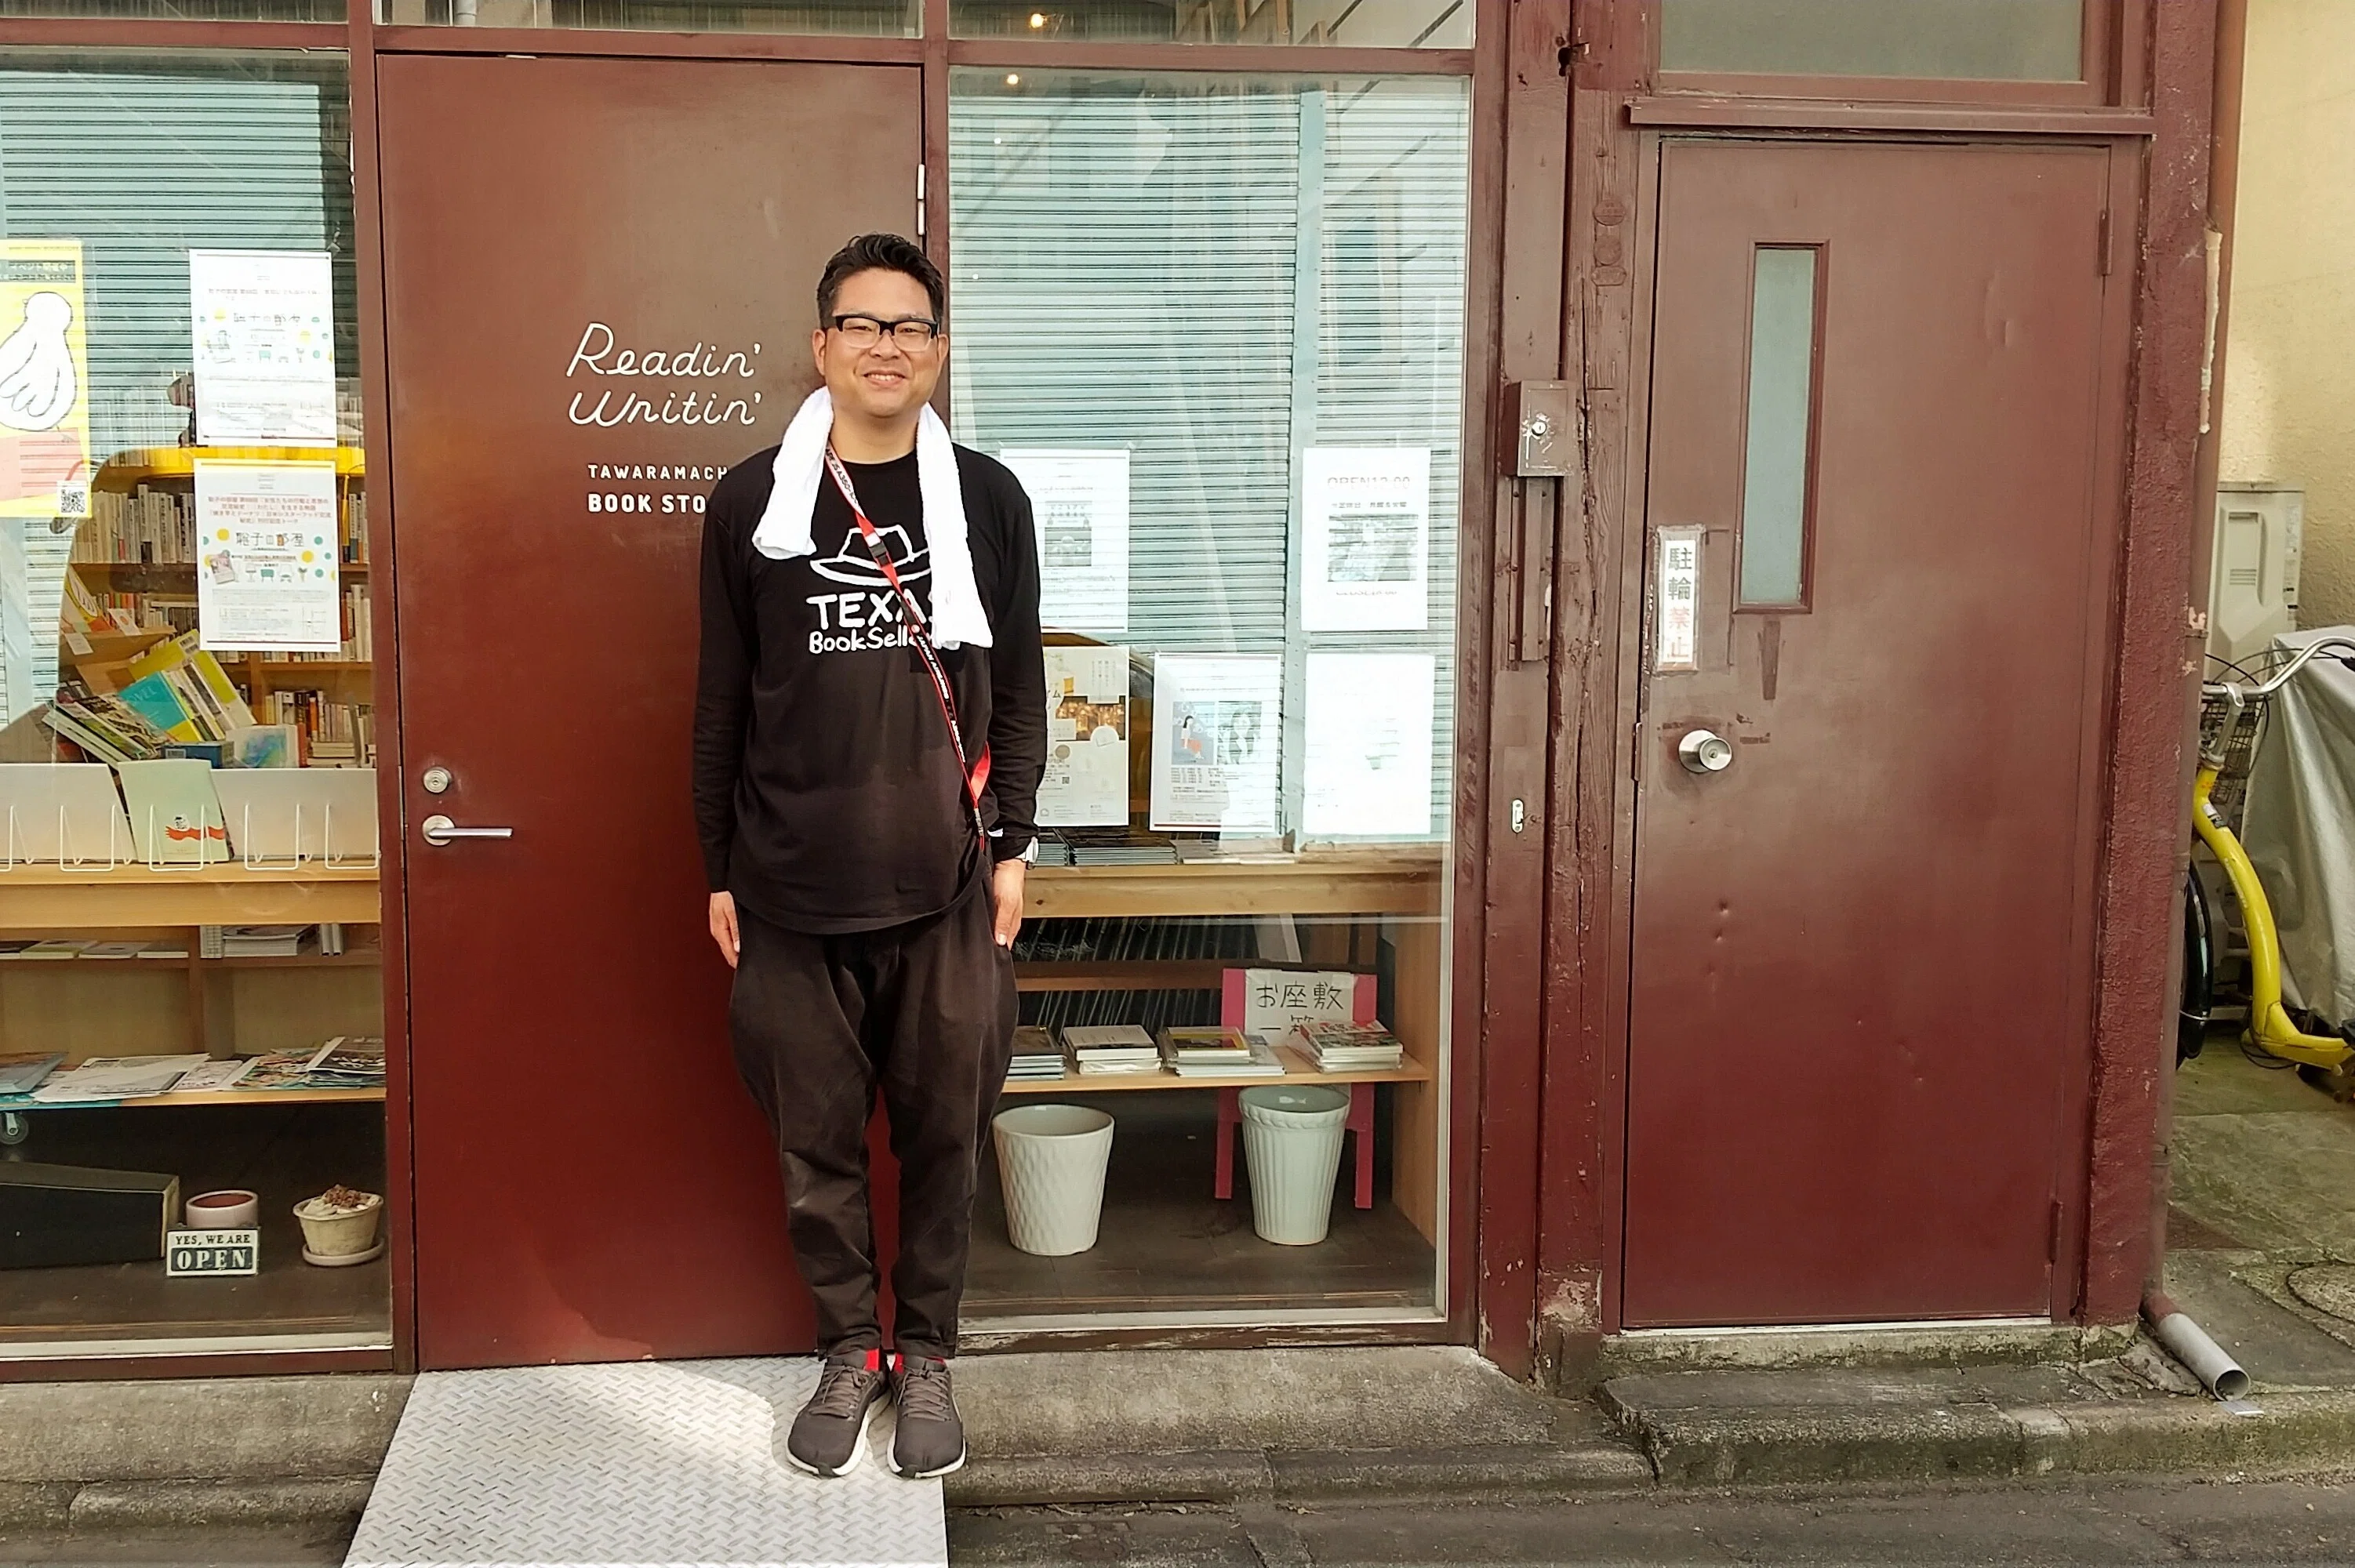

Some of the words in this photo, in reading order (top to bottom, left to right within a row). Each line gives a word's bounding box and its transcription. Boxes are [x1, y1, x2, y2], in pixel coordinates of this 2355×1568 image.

[566, 322, 761, 377] Readin'
[569, 390, 761, 426] Writin'
[588, 464, 728, 480] TAWARAMACH
[588, 493, 652, 514] BOOK
[661, 494, 707, 514] STO
[805, 588, 932, 630] TEXA
[1667, 547, 1693, 659] 駐輪禁止
[809, 626, 932, 655] BookSell
[1256, 981, 1343, 1011] お座敷
[175, 1236, 202, 1246] YES,
[205, 1235, 224, 1244] WE
[227, 1234, 250, 1244] ARE
[176, 1250, 247, 1270] OPEN
